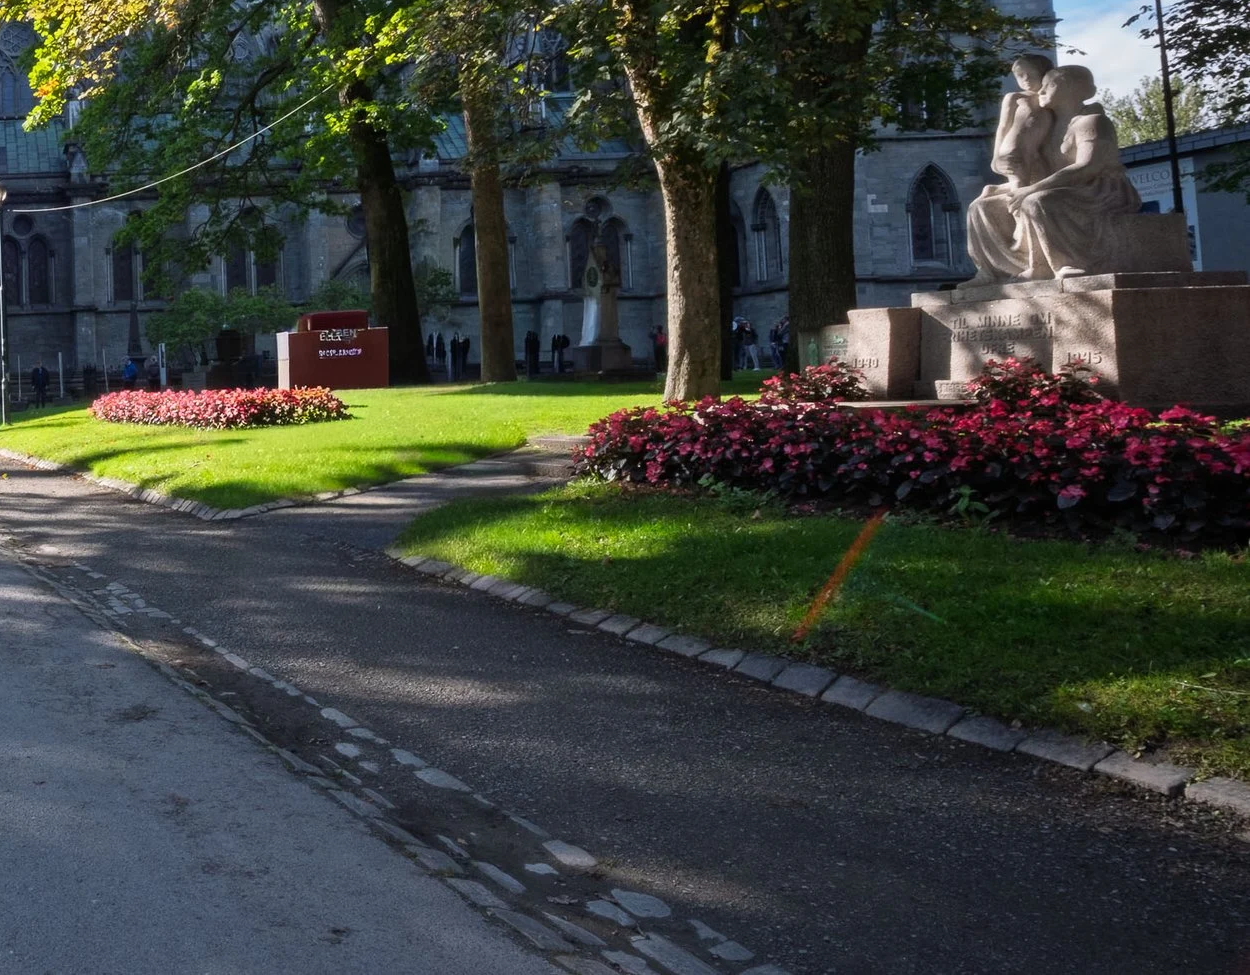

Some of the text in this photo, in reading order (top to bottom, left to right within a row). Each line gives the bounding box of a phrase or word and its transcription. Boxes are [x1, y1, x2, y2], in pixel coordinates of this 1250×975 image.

[1131, 163, 1191, 184] WELCOE
[951, 311, 1051, 329] TIL MINNE OM
[852, 357, 879, 369] 1940
[1065, 351, 1103, 365] 1945
